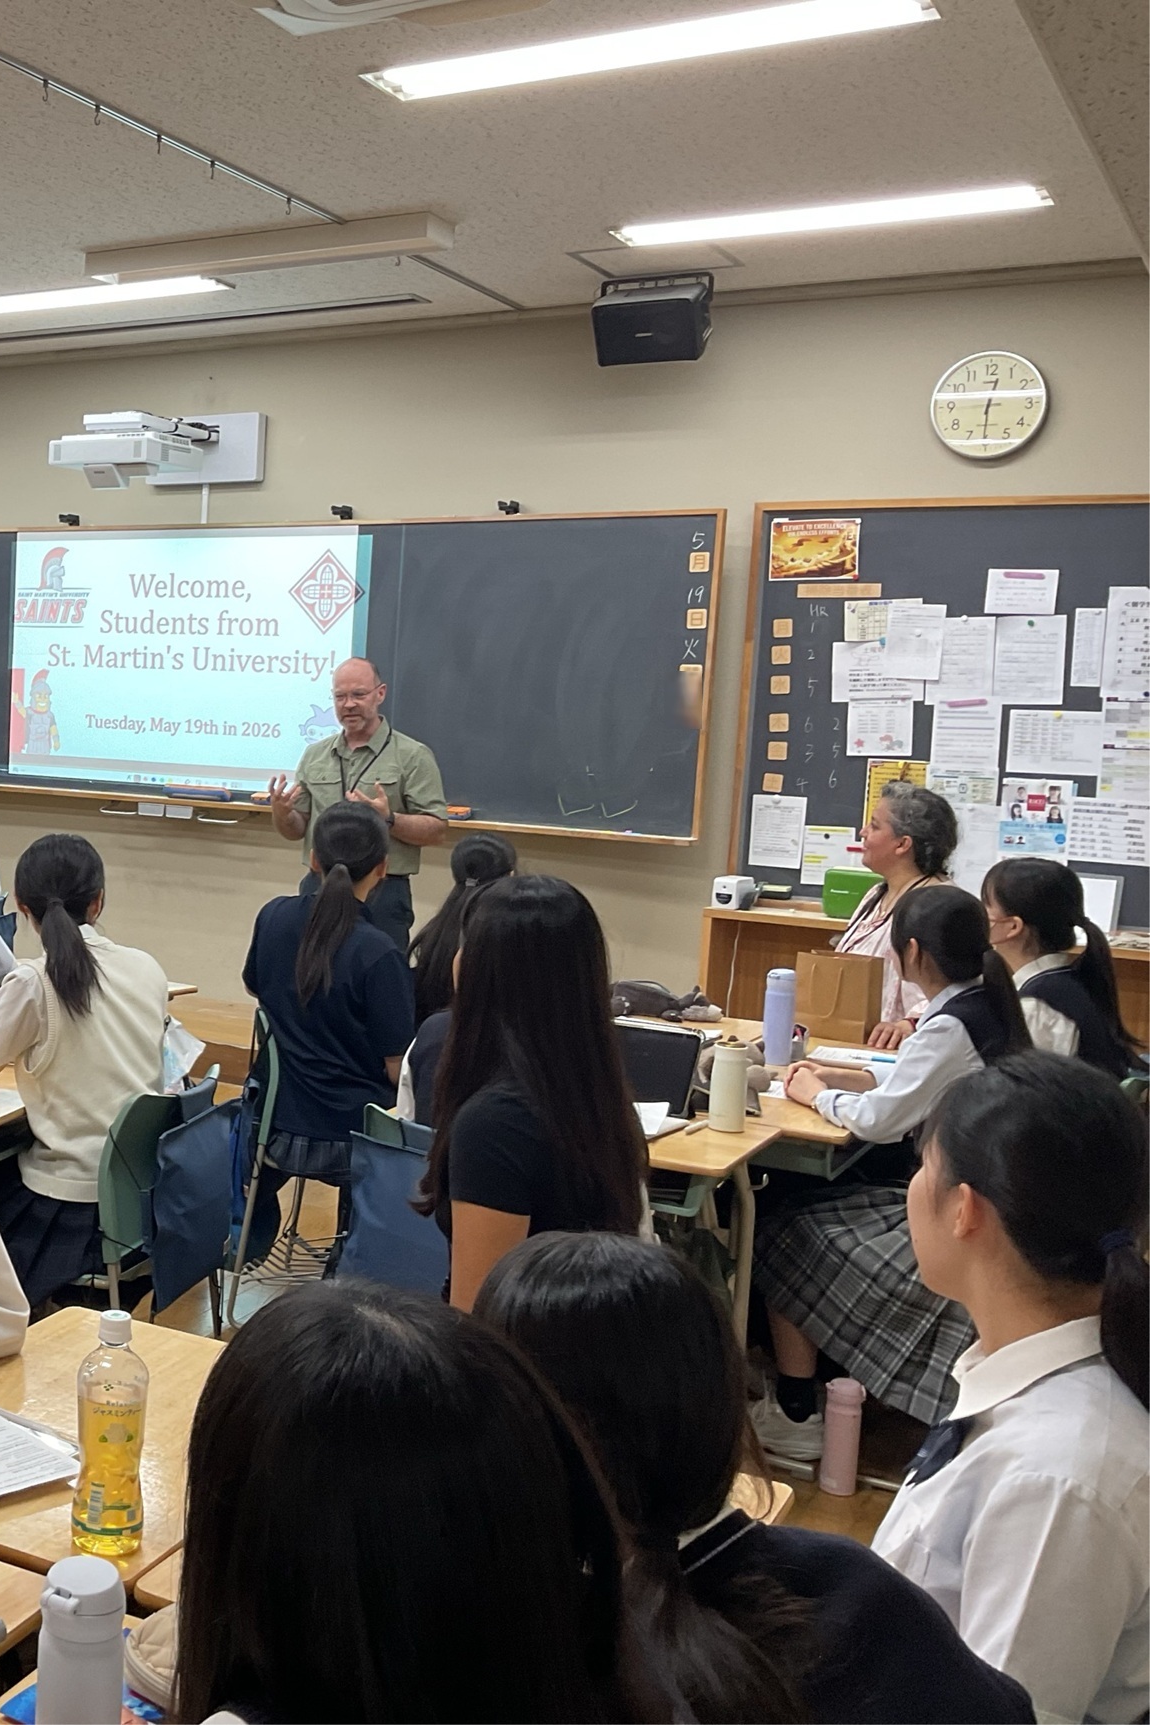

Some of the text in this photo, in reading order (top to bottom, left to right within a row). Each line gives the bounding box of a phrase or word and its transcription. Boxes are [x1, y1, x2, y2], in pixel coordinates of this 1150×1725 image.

[966, 370, 977, 382] 11
[985, 363, 999, 376] 12
[952, 383, 966, 393] 10
[1019, 379, 1029, 390] 2
[946, 401, 956, 414] 9
[1024, 397, 1034, 409] 3
[951, 418, 960, 430] 8
[1016, 416, 1025, 427] 4
[965, 430, 974, 440] 7
[1001, 427, 1011, 440] 5
[691, 531, 706, 550] 5
[129, 573, 252, 602] Welcome,
[687, 585, 705, 604] 19
[14, 598, 88, 624] SAINTS
[809, 603, 829, 617] HR
[100, 609, 280, 637] Students from
[810, 622, 816, 634] 1
[807, 649, 816, 660] 2
[47, 643, 336, 682] St. Martin's University!
[807, 677, 819, 698] 5
[85, 714, 282, 739] Tuesday, May 19th in 2026
[804, 716, 813, 733] 6
[832, 717, 840, 731] 2
[804, 742, 841, 764] 3 5
[828, 769, 838, 788] 6
